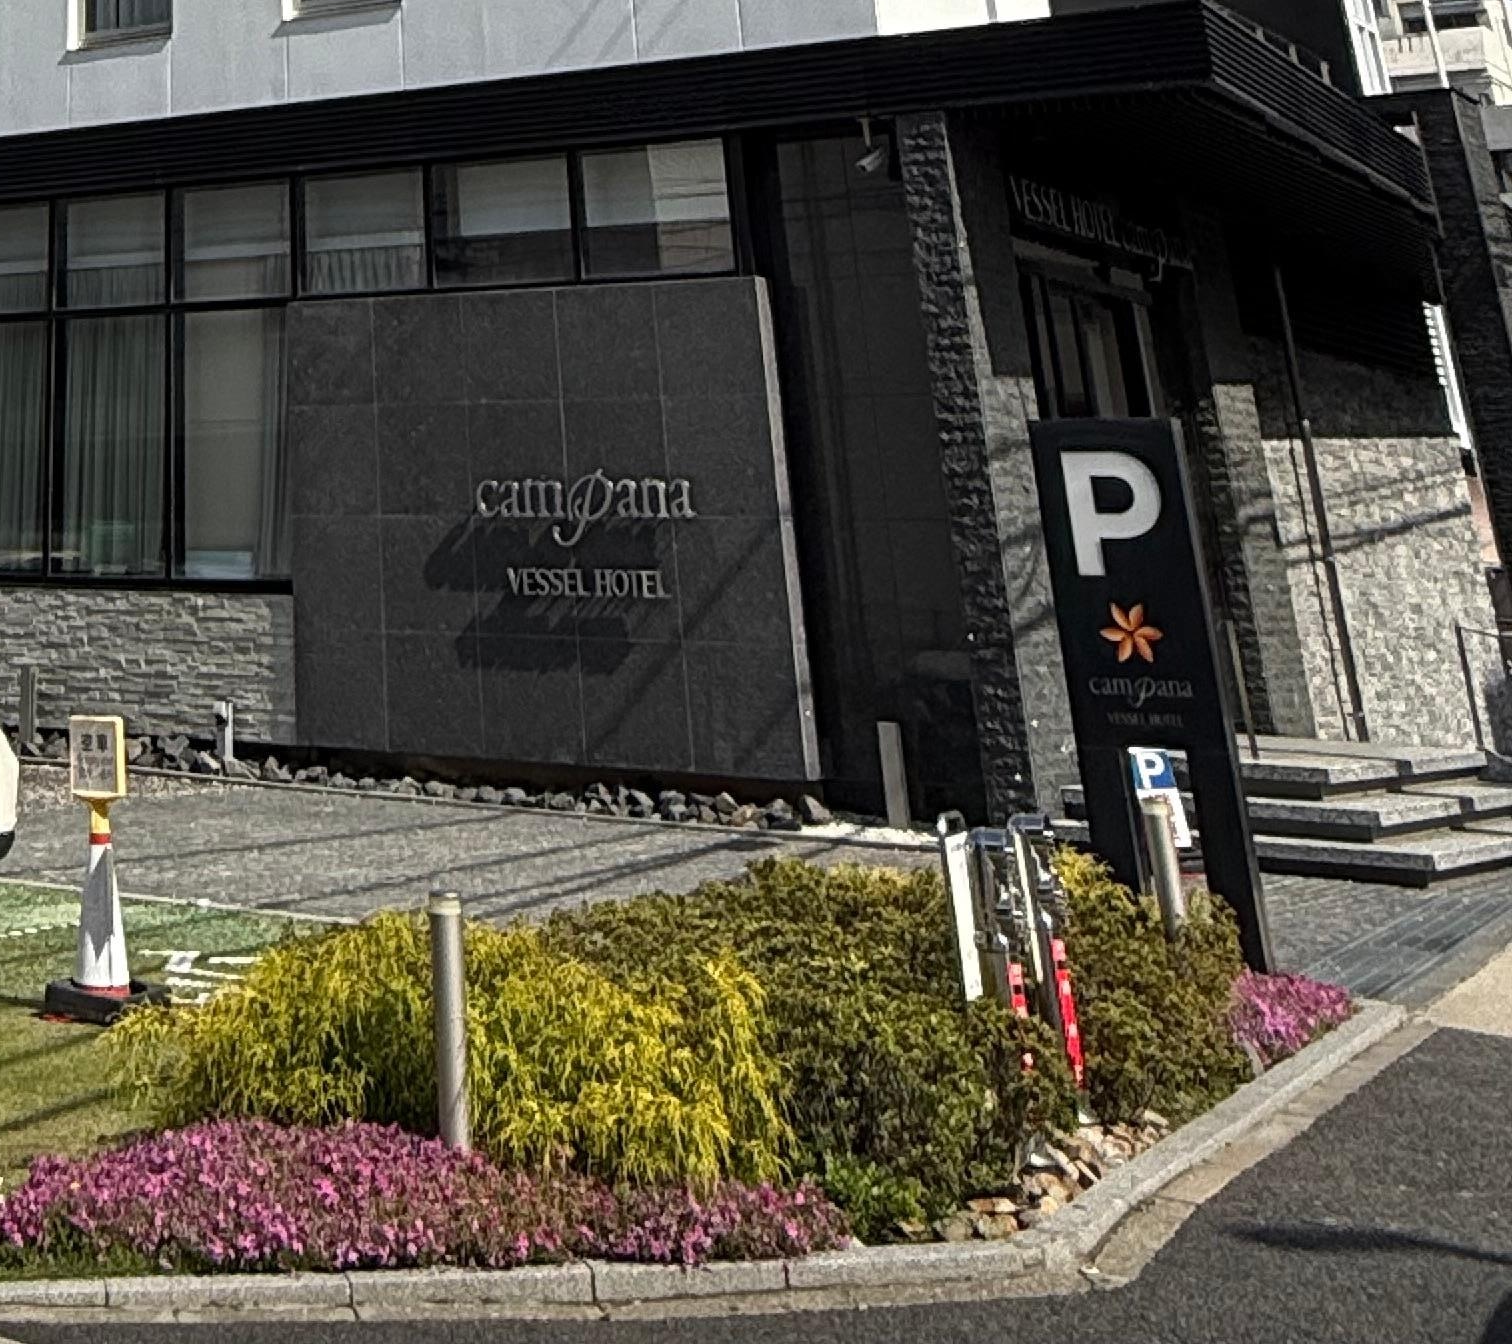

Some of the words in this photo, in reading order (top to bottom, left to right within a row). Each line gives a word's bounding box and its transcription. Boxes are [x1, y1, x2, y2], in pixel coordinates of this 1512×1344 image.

[1009, 175, 1071, 232] VESSEL
[1070, 193, 1122, 248] HOTEL
[476, 468, 698, 547] campana
[1060, 451, 1162, 577] P
[507, 566, 592, 598] VESSEL
[595, 568, 672, 600] HOTEL
[1088, 676, 1194, 709] campana
[1136, 752, 1165, 789] P
